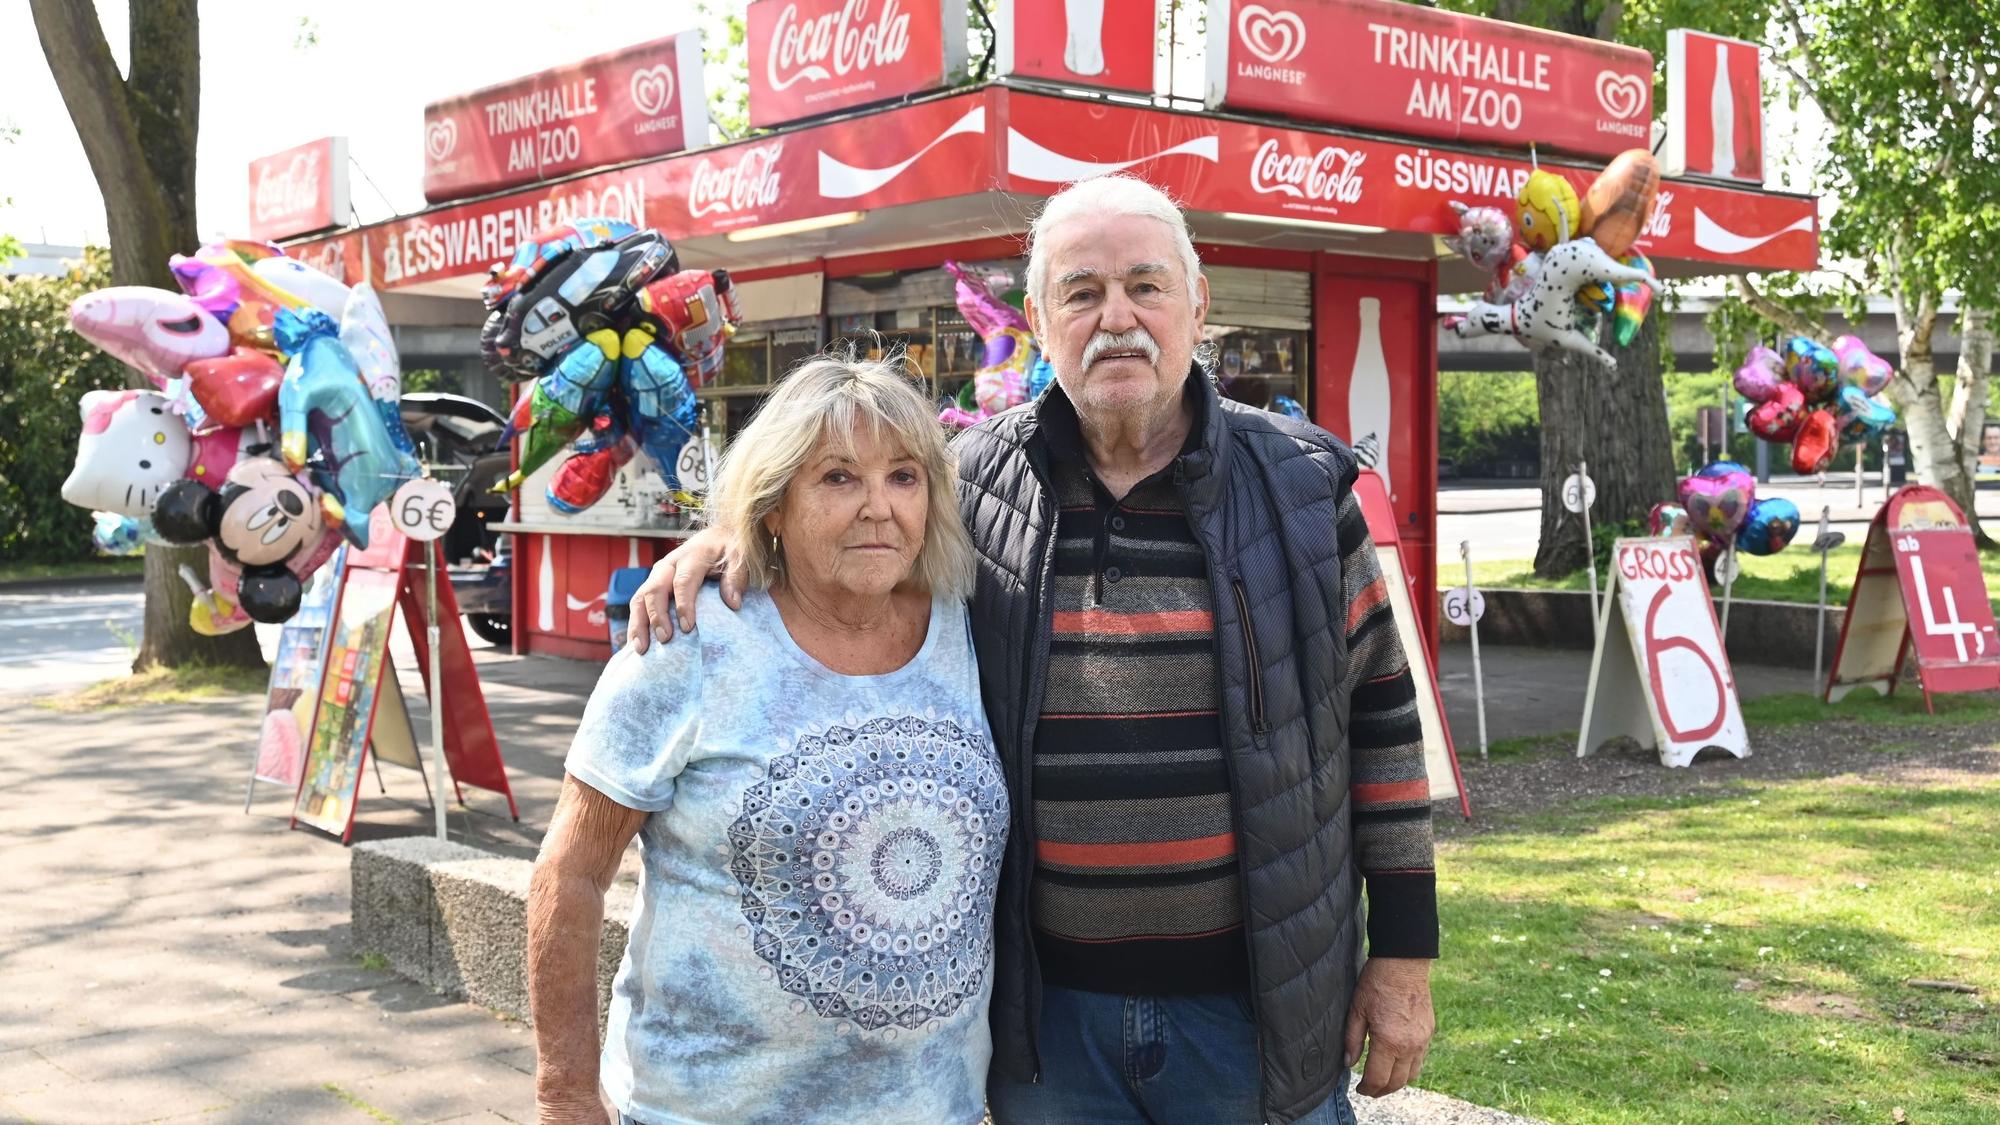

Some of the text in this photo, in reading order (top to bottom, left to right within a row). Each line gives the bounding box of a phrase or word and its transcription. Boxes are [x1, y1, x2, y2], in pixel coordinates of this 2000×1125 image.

[768, 0, 911, 91] Coca-Cola
[1238, 61, 1303, 85] LANGNESE
[1368, 22, 1551, 91] TRINKHALLE
[485, 78, 597, 136] TRINKHALLE
[1406, 78, 1522, 130] AM ZOO
[508, 125, 580, 172] AM ZOO
[1250, 138, 1367, 204] Coca-Cola
[688, 142, 784, 218] Coca-Cola
[401, 495, 452, 532] 6€
[1618, 547, 1697, 582] GROSS
[1897, 535, 1920, 552] ab
[1645, 583, 1727, 743] 6
